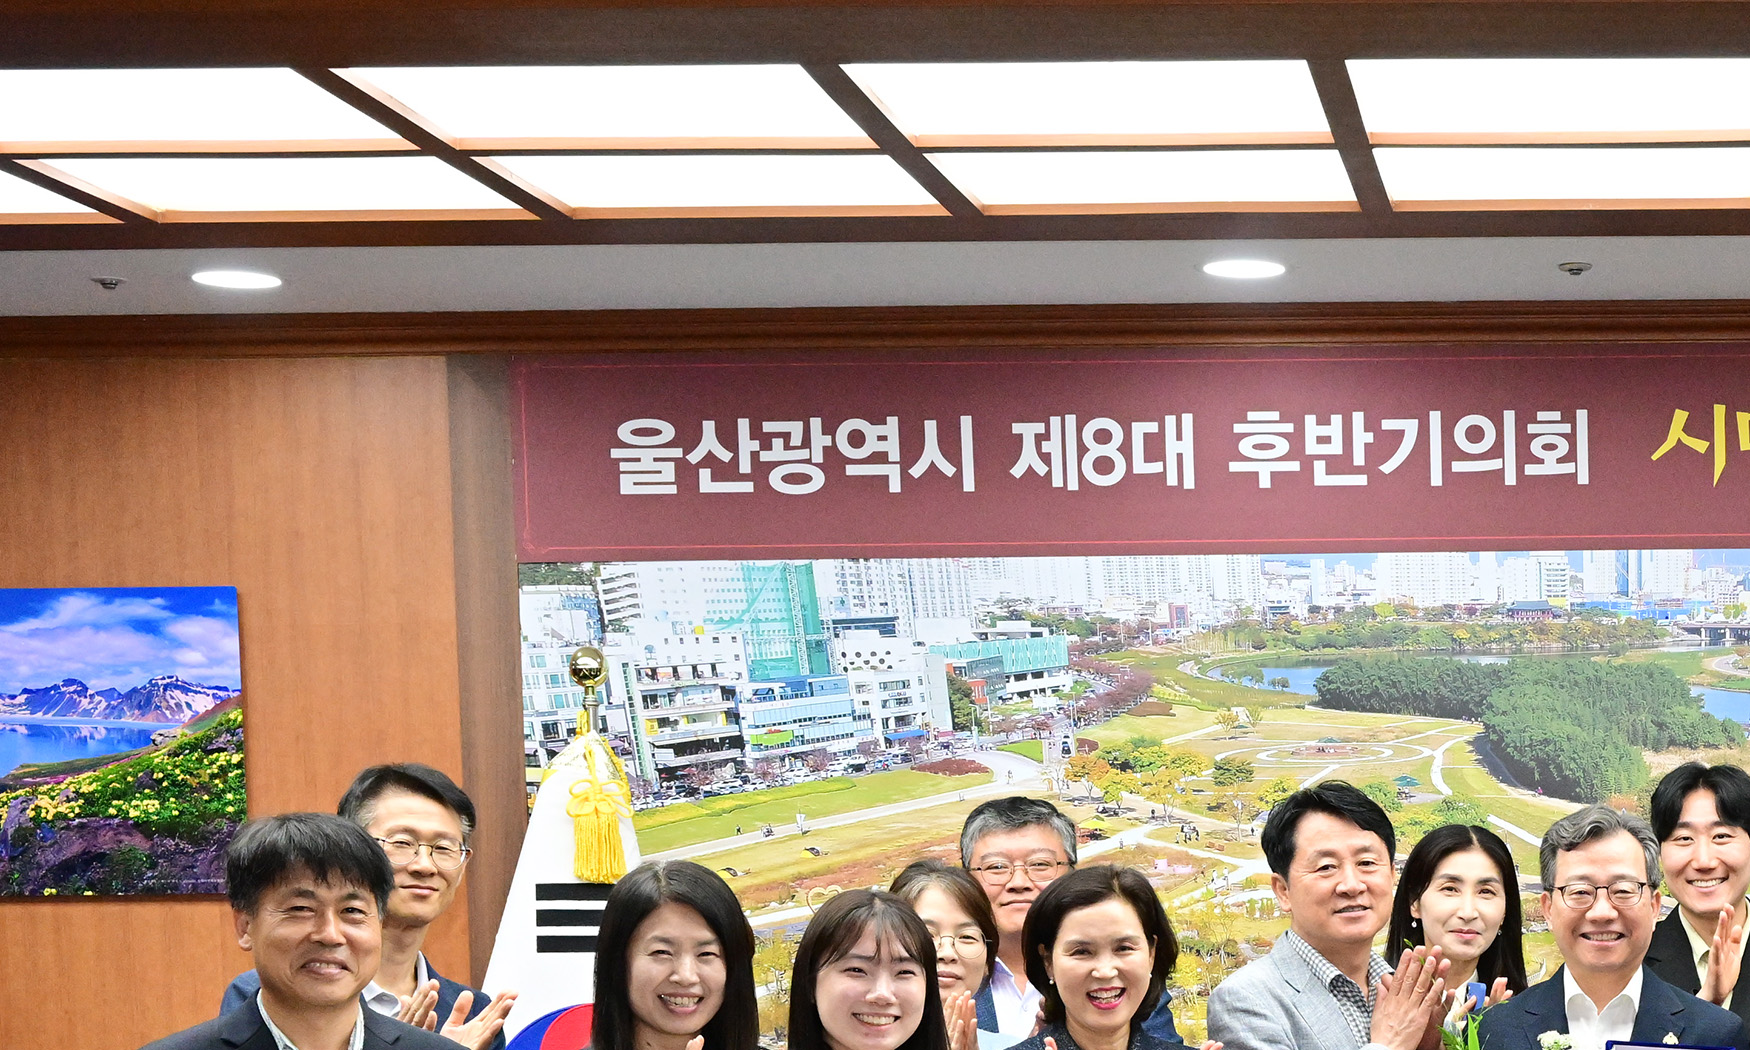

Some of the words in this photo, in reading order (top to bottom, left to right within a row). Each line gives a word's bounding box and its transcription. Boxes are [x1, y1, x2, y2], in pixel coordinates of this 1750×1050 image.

[610, 414, 976, 495] 울산광역시
[1009, 412, 1197, 491] 제8대
[1228, 409, 1590, 489] 후반기의회
